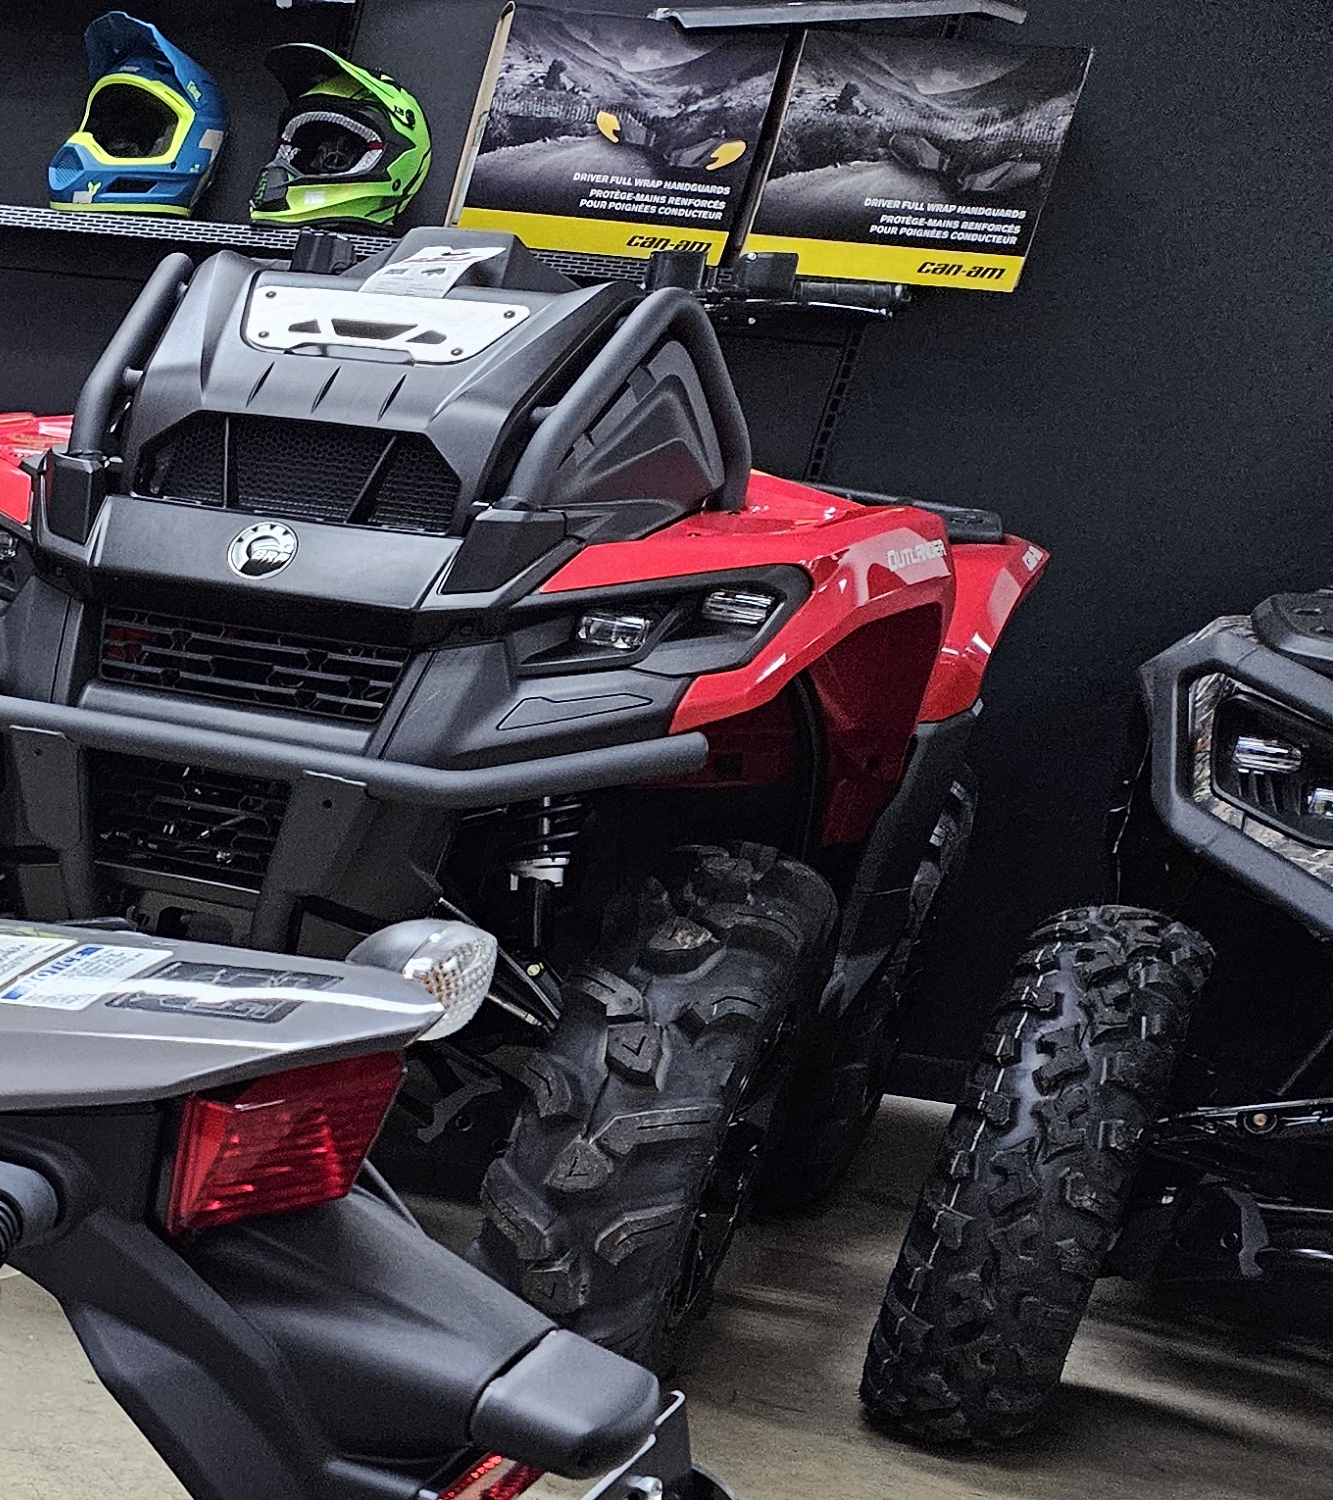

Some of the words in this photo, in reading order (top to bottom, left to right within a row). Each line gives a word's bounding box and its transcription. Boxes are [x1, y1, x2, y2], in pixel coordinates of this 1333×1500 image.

[573, 172, 609, 184] DRIVER
[609, 175, 633, 187] FULL
[634, 177, 663, 189] WRAP
[663, 181, 731, 196] HANDGUARDS
[579, 199, 608, 210] POUR
[657, 206, 723, 221] CONDUCTEUR
[864, 197, 901, 209] DRIVER
[901, 200, 925, 212] FULL
[926, 203, 956, 214] WRAP
[956, 205, 1027, 220] HANDGUARDS
[626, 234, 712, 252] can-am
[869, 225, 898, 236] POUR
[950, 231, 1018, 246] CONDUCTEUR
[917, 260, 1006, 281] can-am
